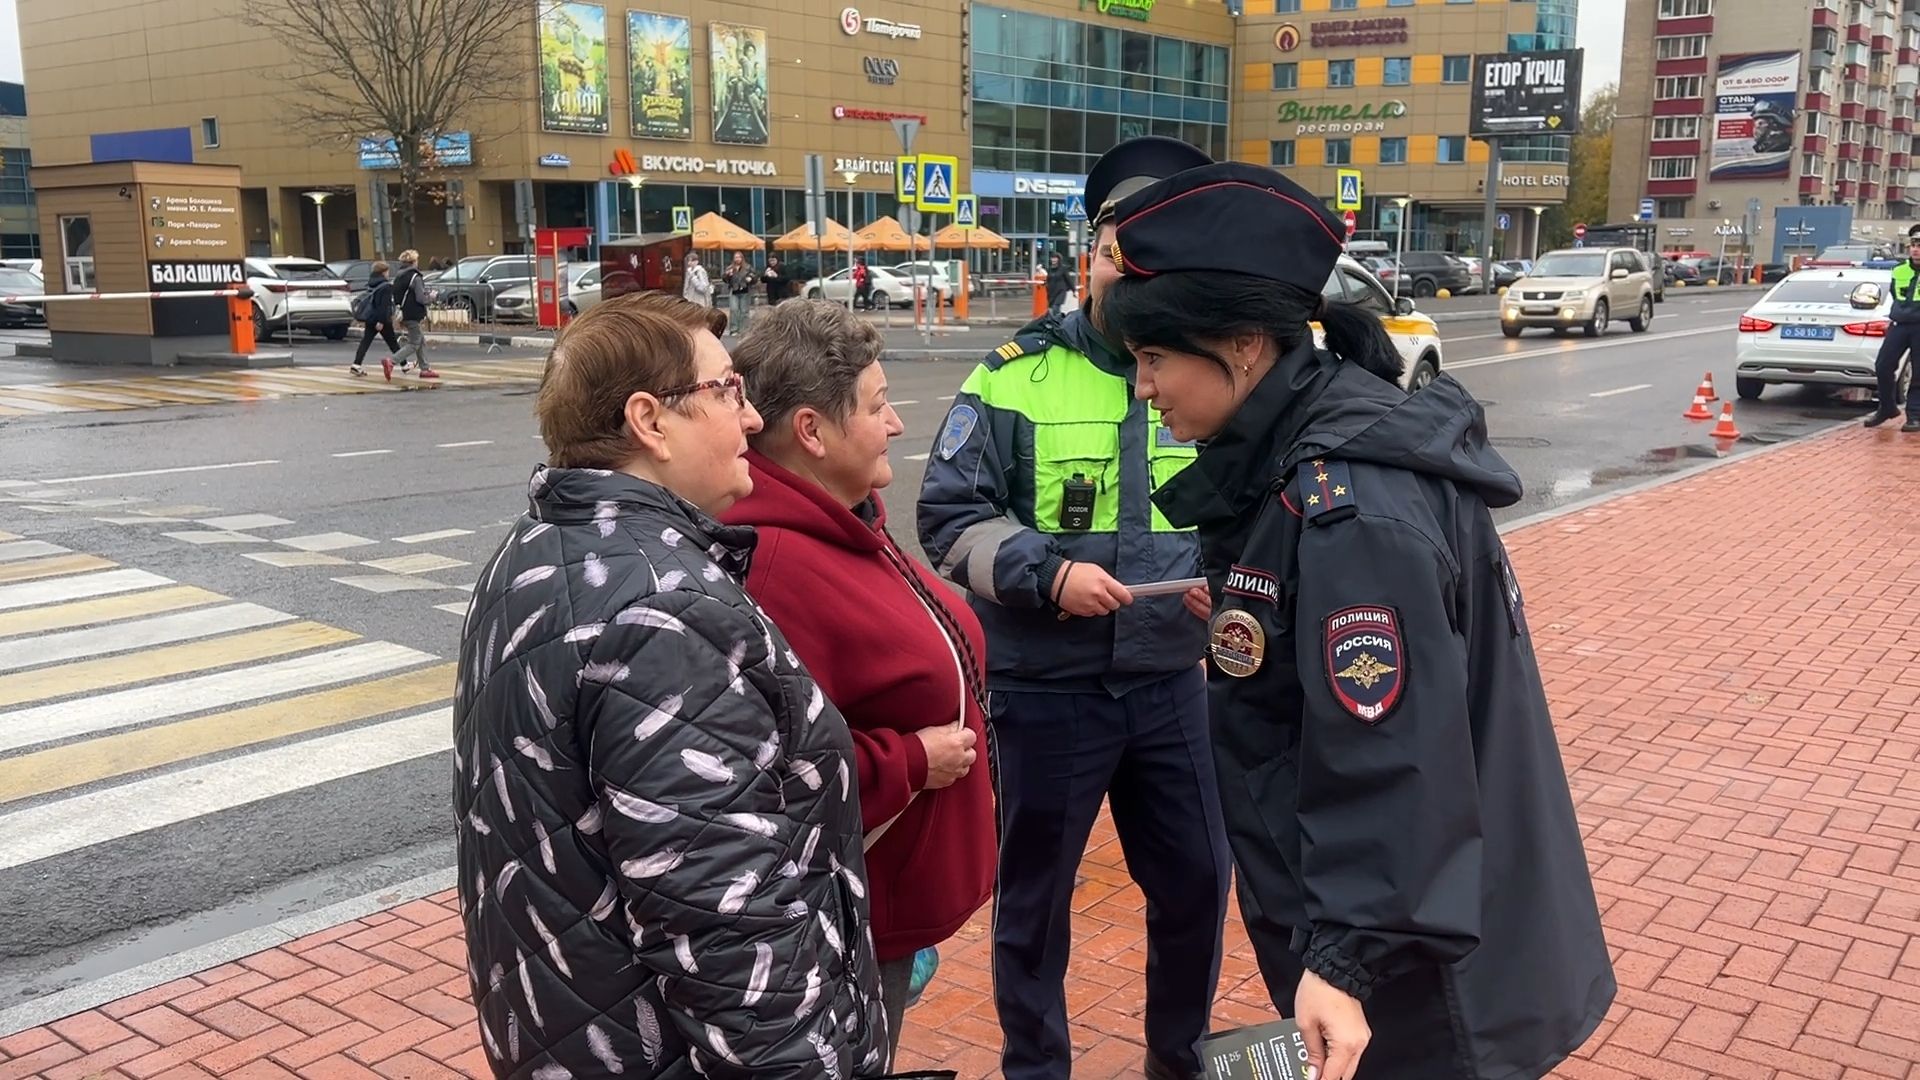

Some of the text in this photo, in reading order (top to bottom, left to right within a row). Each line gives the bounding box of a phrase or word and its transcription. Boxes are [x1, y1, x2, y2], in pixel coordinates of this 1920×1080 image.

[1485, 59, 1565, 87] ЕГОР КРИД
[1719, 96, 1755, 104] СТАНЬ
[1296, 121, 1385, 136] ресторан
[730, 160, 777, 176] ТОЧКА
[1015, 177, 1048, 193] DNS
[1503, 175, 1538, 186] HOTEL
[166, 196, 223, 205] Арена Балашиха
[167, 220, 185, 229] Парк
[169, 238, 192, 247] Арена
[152, 264, 243, 283] БАЛАШИХА
[1331, 612, 1390, 631] ПОЛИЦИЯ
[1336, 635, 1393, 657] РОССИЯ
[1356, 702, 1384, 719] МВД
